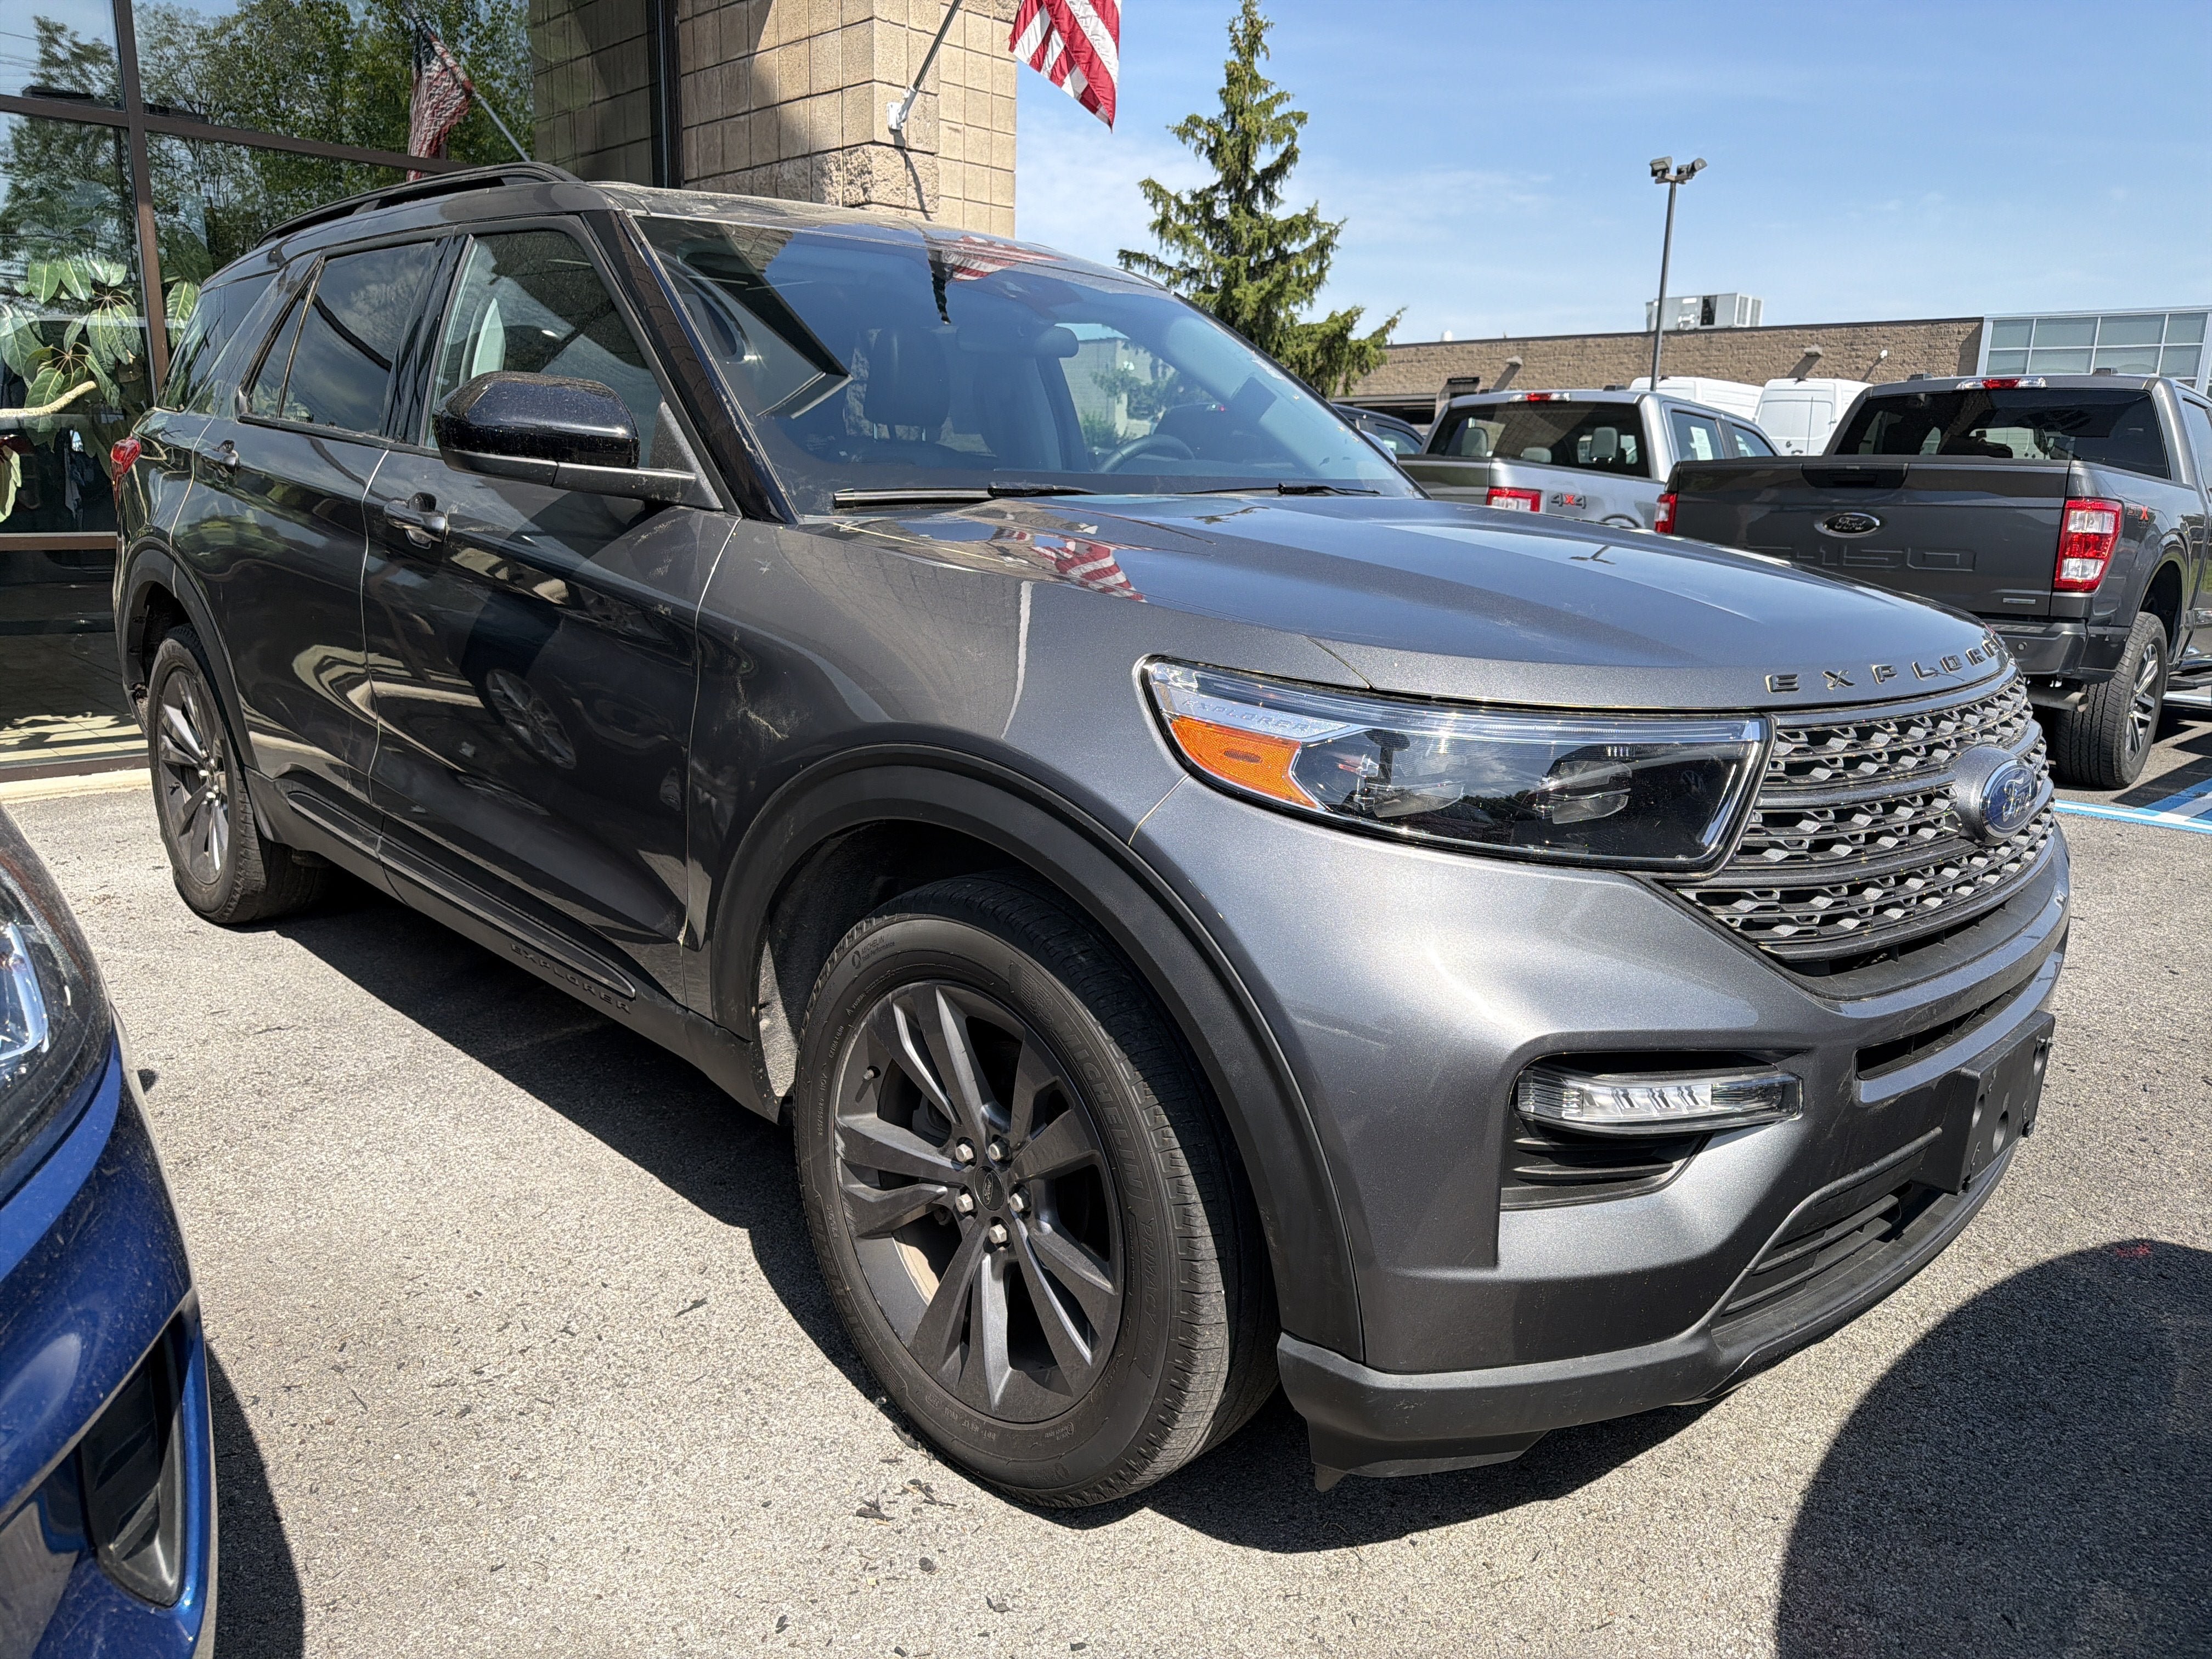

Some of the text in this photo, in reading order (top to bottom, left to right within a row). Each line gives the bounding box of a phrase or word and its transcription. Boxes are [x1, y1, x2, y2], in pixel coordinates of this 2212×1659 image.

[1835, 516, 1866, 531] Ford
[511, 943, 631, 1014] EXPLORER
[861, 935, 885, 955] MICHELIN
[1062, 1022, 1146, 1189] MICHELIN
[1140, 1221, 1157, 1325] PRIMACY
